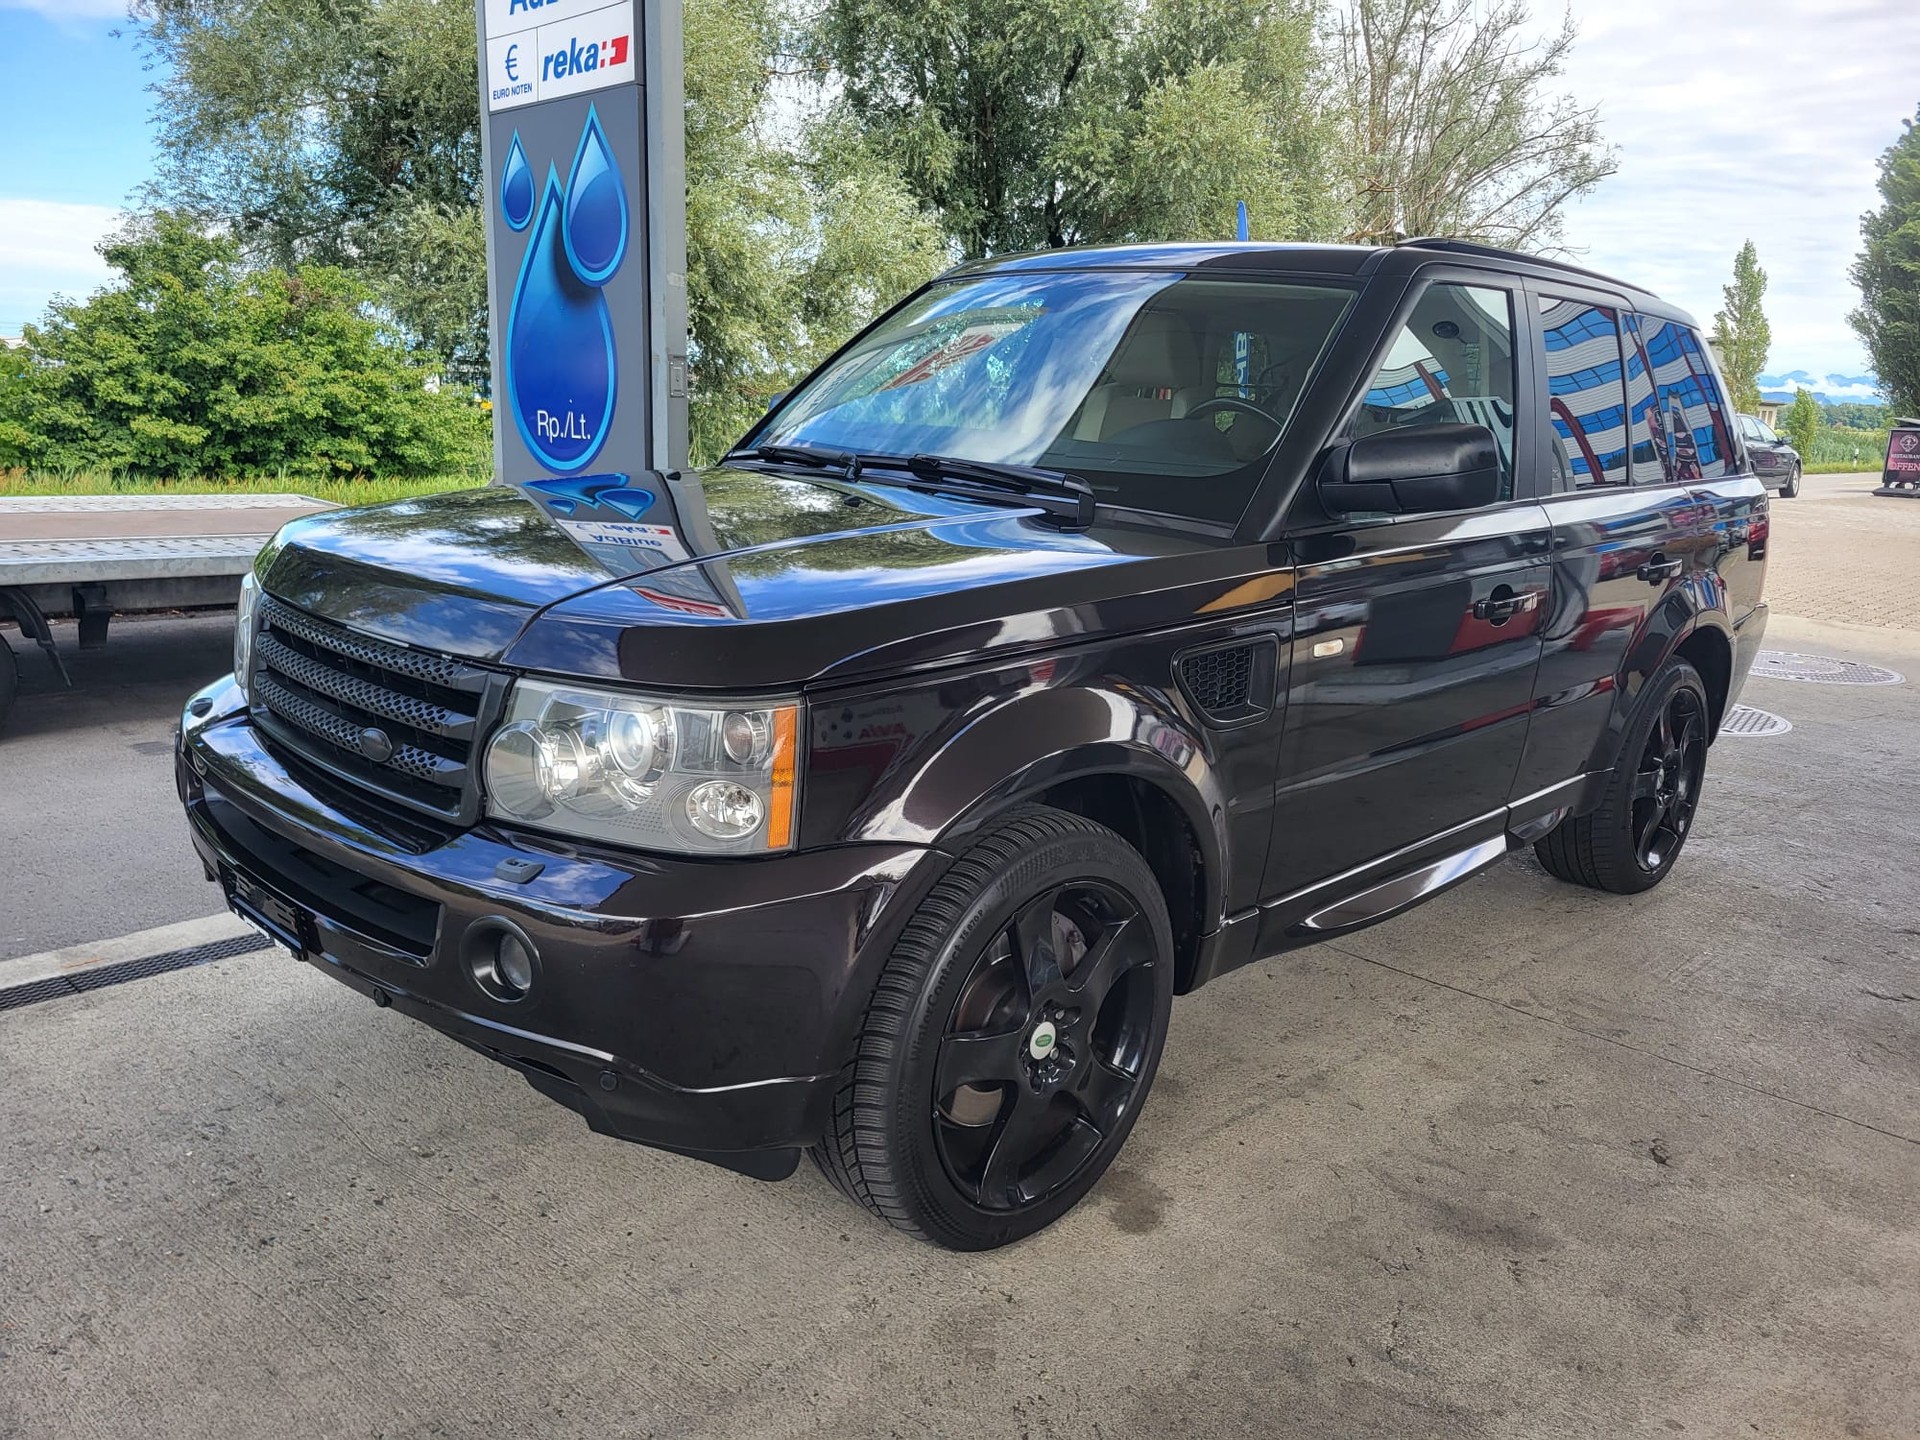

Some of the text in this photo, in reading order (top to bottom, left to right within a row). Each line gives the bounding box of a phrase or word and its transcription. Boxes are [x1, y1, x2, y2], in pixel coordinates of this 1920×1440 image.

[505, 44, 519, 82] €
[493, 82, 533, 100] EURO NOTEN
[537, 410, 591, 443] Rp./Lt.
[909, 944, 960, 1061] WinterContact
